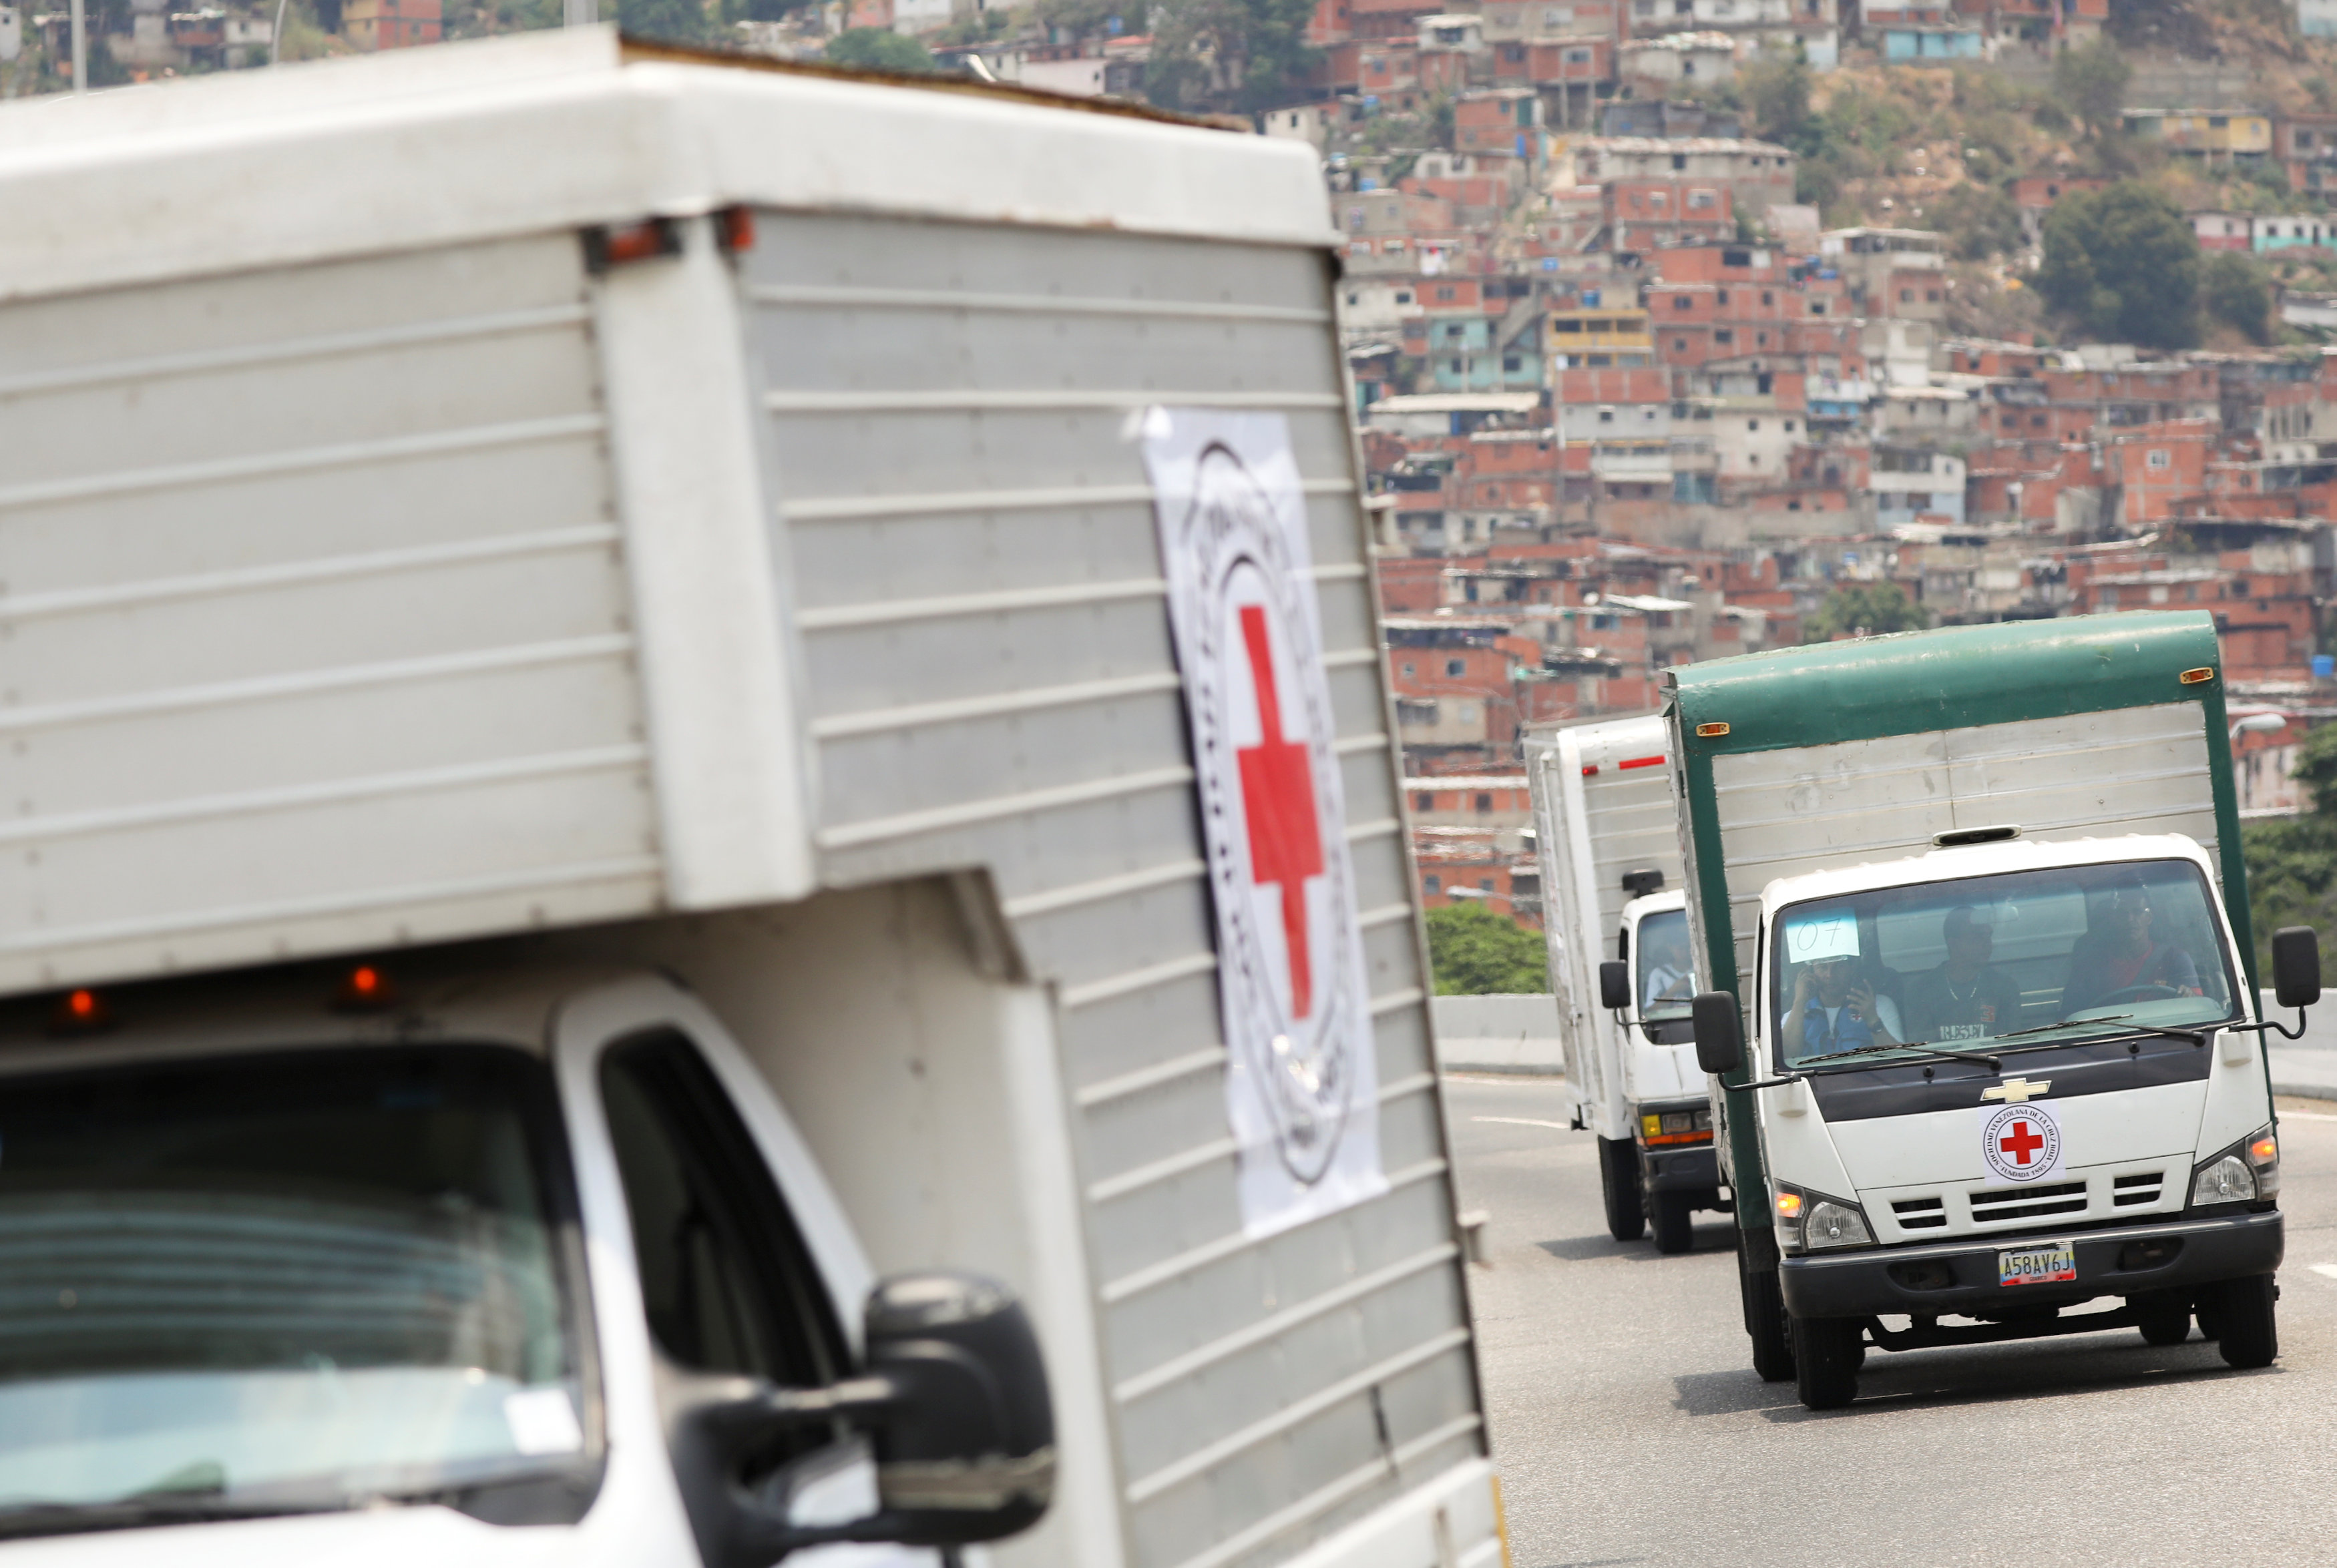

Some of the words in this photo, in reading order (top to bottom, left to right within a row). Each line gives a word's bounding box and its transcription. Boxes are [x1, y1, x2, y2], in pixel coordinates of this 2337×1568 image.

[1797, 918, 1841, 951] 07
[1991, 1109, 2027, 1131] VENEZOLANA
[2030, 1111, 2039, 1119] DE
[2039, 1117, 2047, 1125] LA
[2046, 1125, 2056, 1142] CRUZ
[1987, 1133, 1999, 1165] SOCIEDAD
[2047, 1144, 2057, 1160] ROJA
[2000, 1167, 2029, 1178] FUNDADA
[2031, 1164, 2046, 1175] 1895
[2004, 1252, 2069, 1276] A58AV6J
